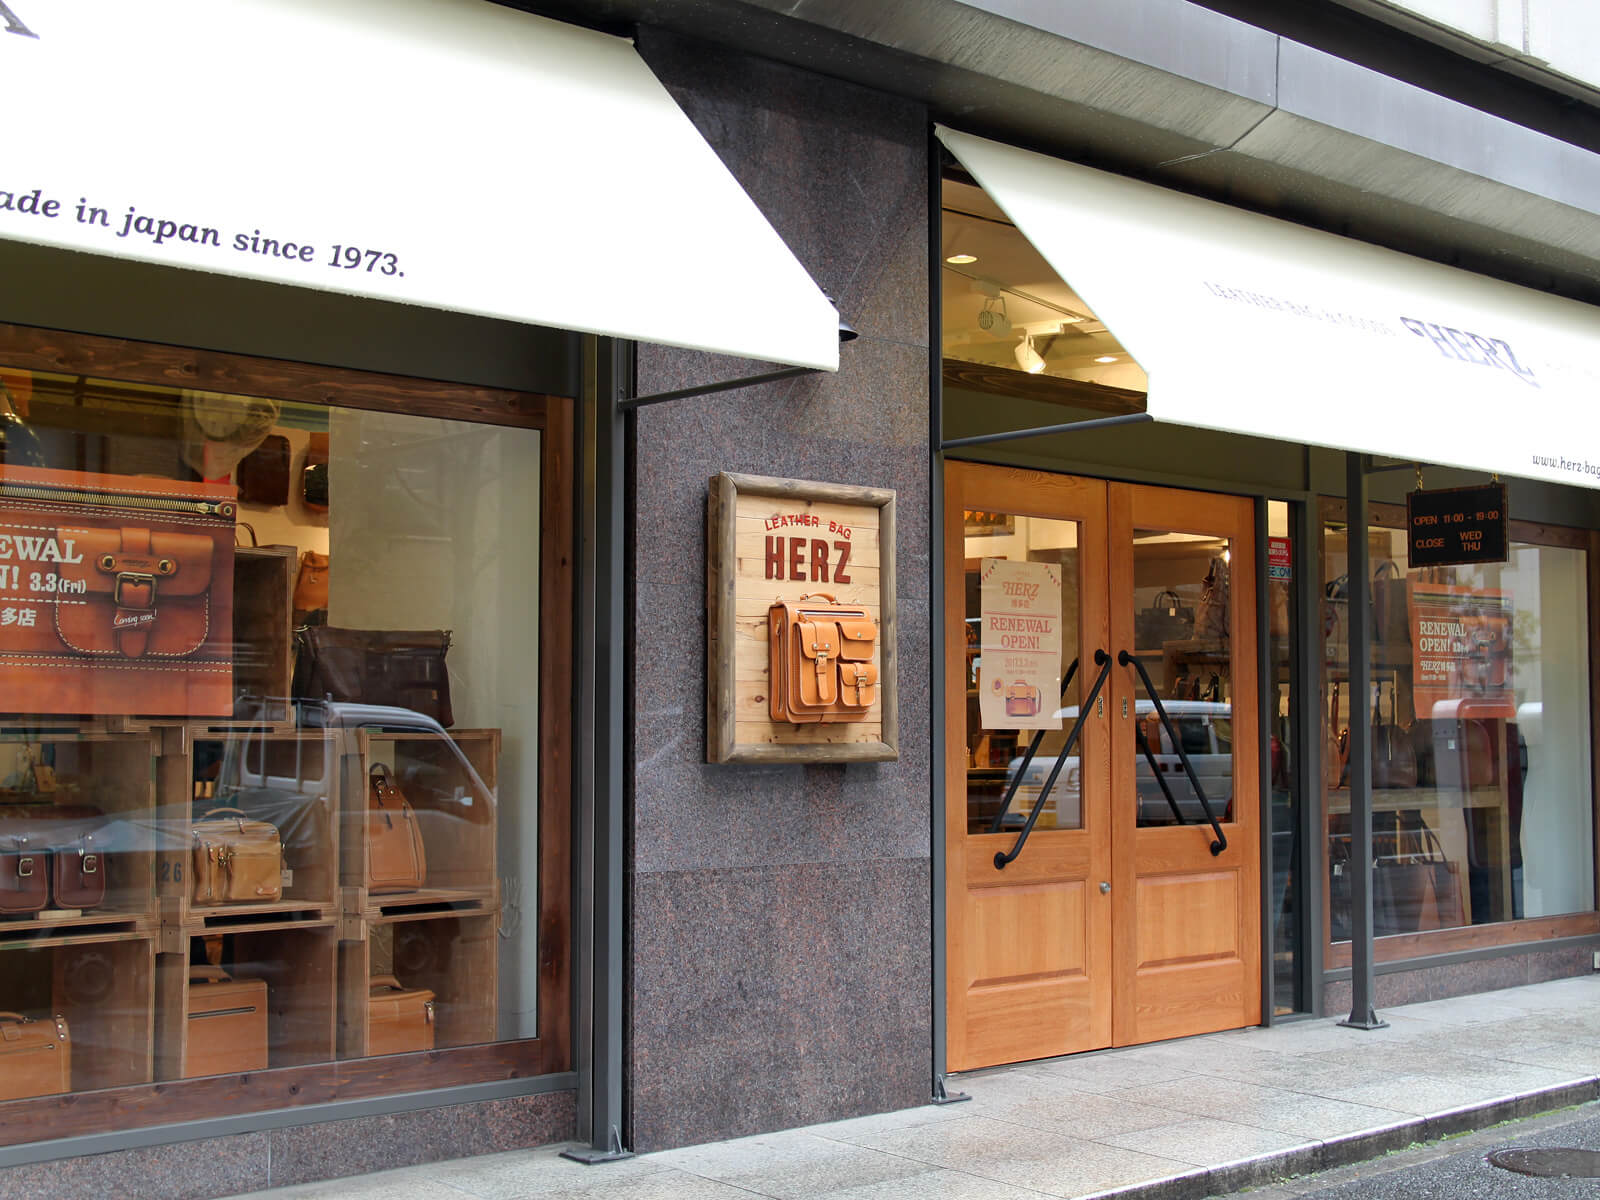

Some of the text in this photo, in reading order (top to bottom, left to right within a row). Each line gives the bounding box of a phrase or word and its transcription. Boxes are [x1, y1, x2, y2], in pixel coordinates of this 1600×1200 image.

[76, 197, 110, 226] in
[116, 206, 221, 246] japan
[233, 229, 315, 262] since
[327, 245, 405, 278] 1973.
[1400, 317, 1541, 388] HERZ
[765, 514, 852, 541] LEATHER BAG
[1414, 515, 1438, 526] OPEN
[1416, 538, 1445, 549] CLOSE
[1460, 530, 1483, 540] WED
[1462, 541, 1481, 551] THU
[765, 535, 851, 584] HERZ
[1002, 581, 1040, 601] HERZ
[989, 616, 1053, 634] RENEWAL
[1419, 621, 1467, 637] RENEWAL
[1001, 633, 1040, 650] OPEN!
[1419, 638, 1450, 653] OPEN!
[161, 861, 182, 882] 26
